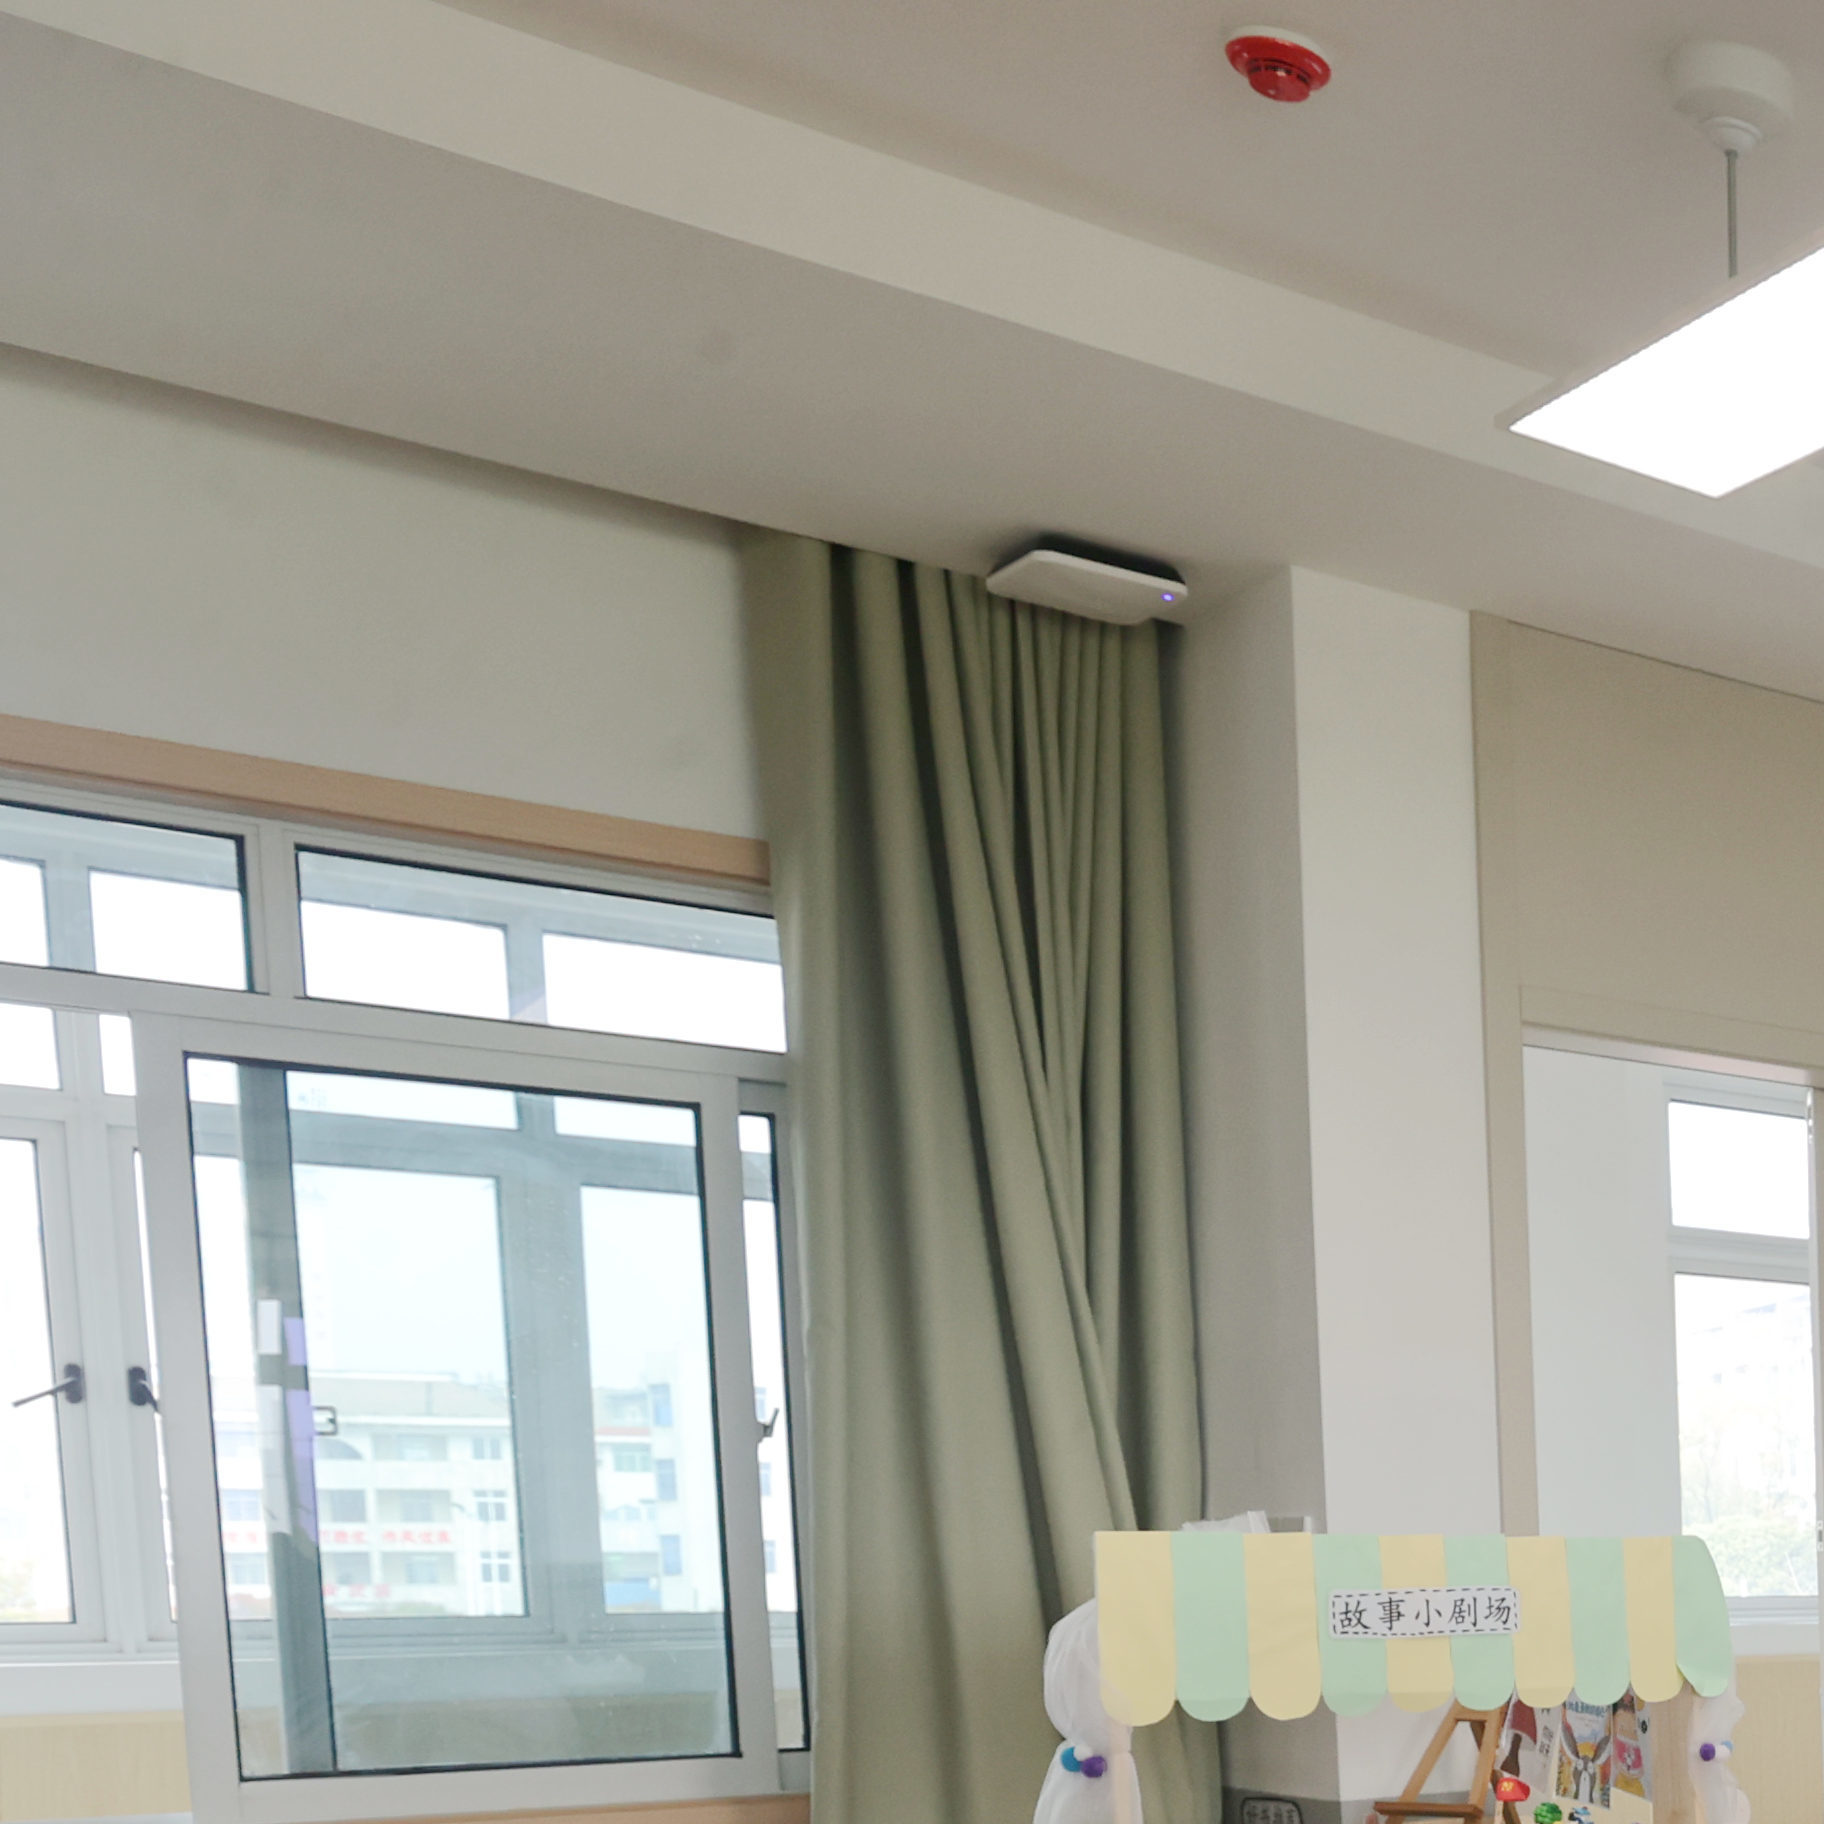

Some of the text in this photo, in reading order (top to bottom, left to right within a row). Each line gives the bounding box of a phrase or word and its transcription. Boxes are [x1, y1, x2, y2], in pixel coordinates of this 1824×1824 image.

[1338, 1596, 1512, 1631] 故事小剧场
